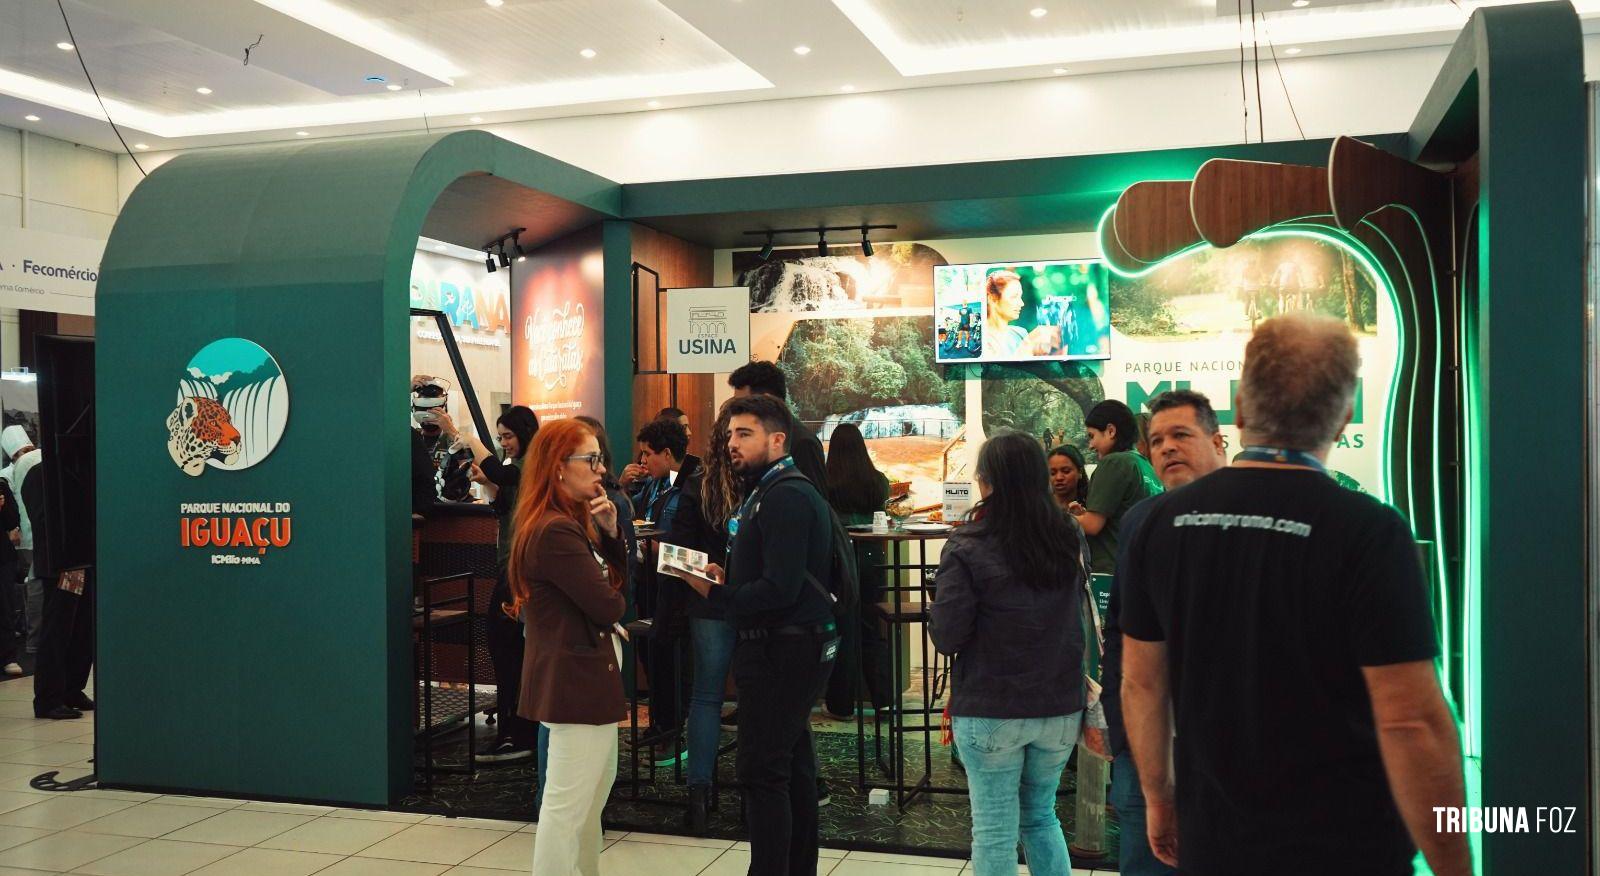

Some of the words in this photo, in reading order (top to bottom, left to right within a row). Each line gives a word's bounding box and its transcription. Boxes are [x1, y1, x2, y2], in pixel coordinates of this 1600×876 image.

[23, 260, 98, 281] Fecomércio
[679, 339, 736, 355] USINA
[1125, 361, 1182, 375] PARQUE
[1190, 360, 1245, 372] NACION
[181, 503, 220, 514] PARQUE
[222, 502, 274, 513] NACIONAL
[275, 502, 291, 513] DO
[181, 517, 292, 555] IGUAÇU
